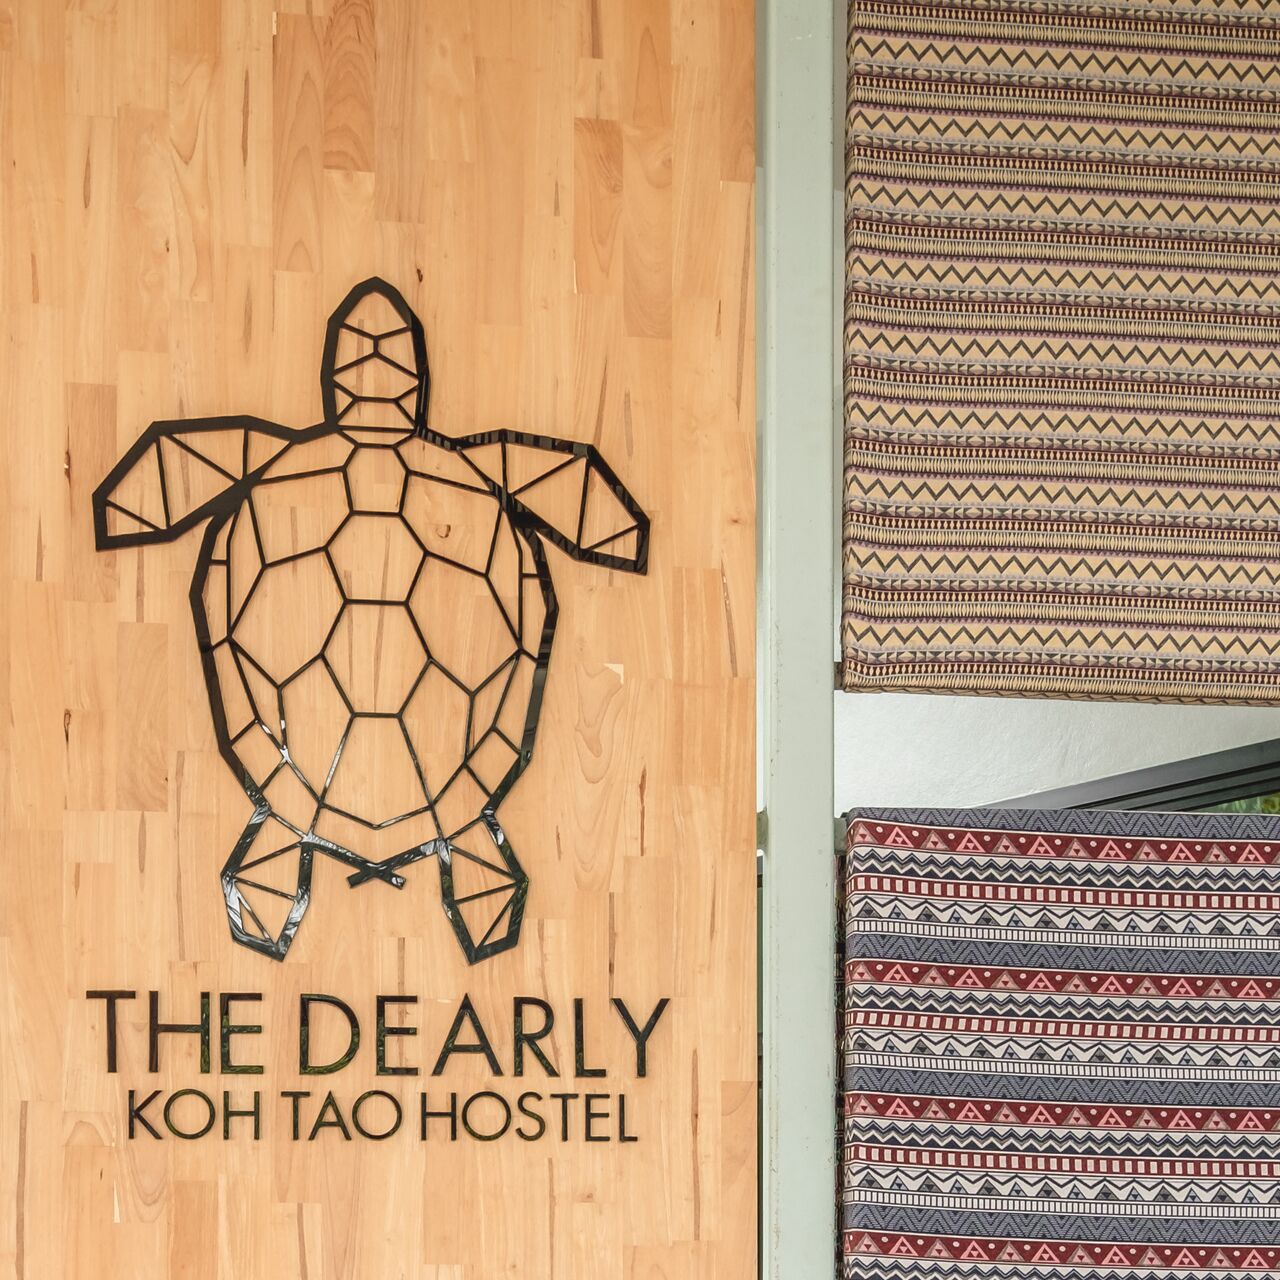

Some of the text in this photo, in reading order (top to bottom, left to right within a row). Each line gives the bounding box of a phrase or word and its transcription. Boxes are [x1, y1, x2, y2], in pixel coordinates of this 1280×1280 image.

[86, 990, 671, 1079] THE DEARLY
[127, 1089, 638, 1143] KOH TAO HOSTEL
